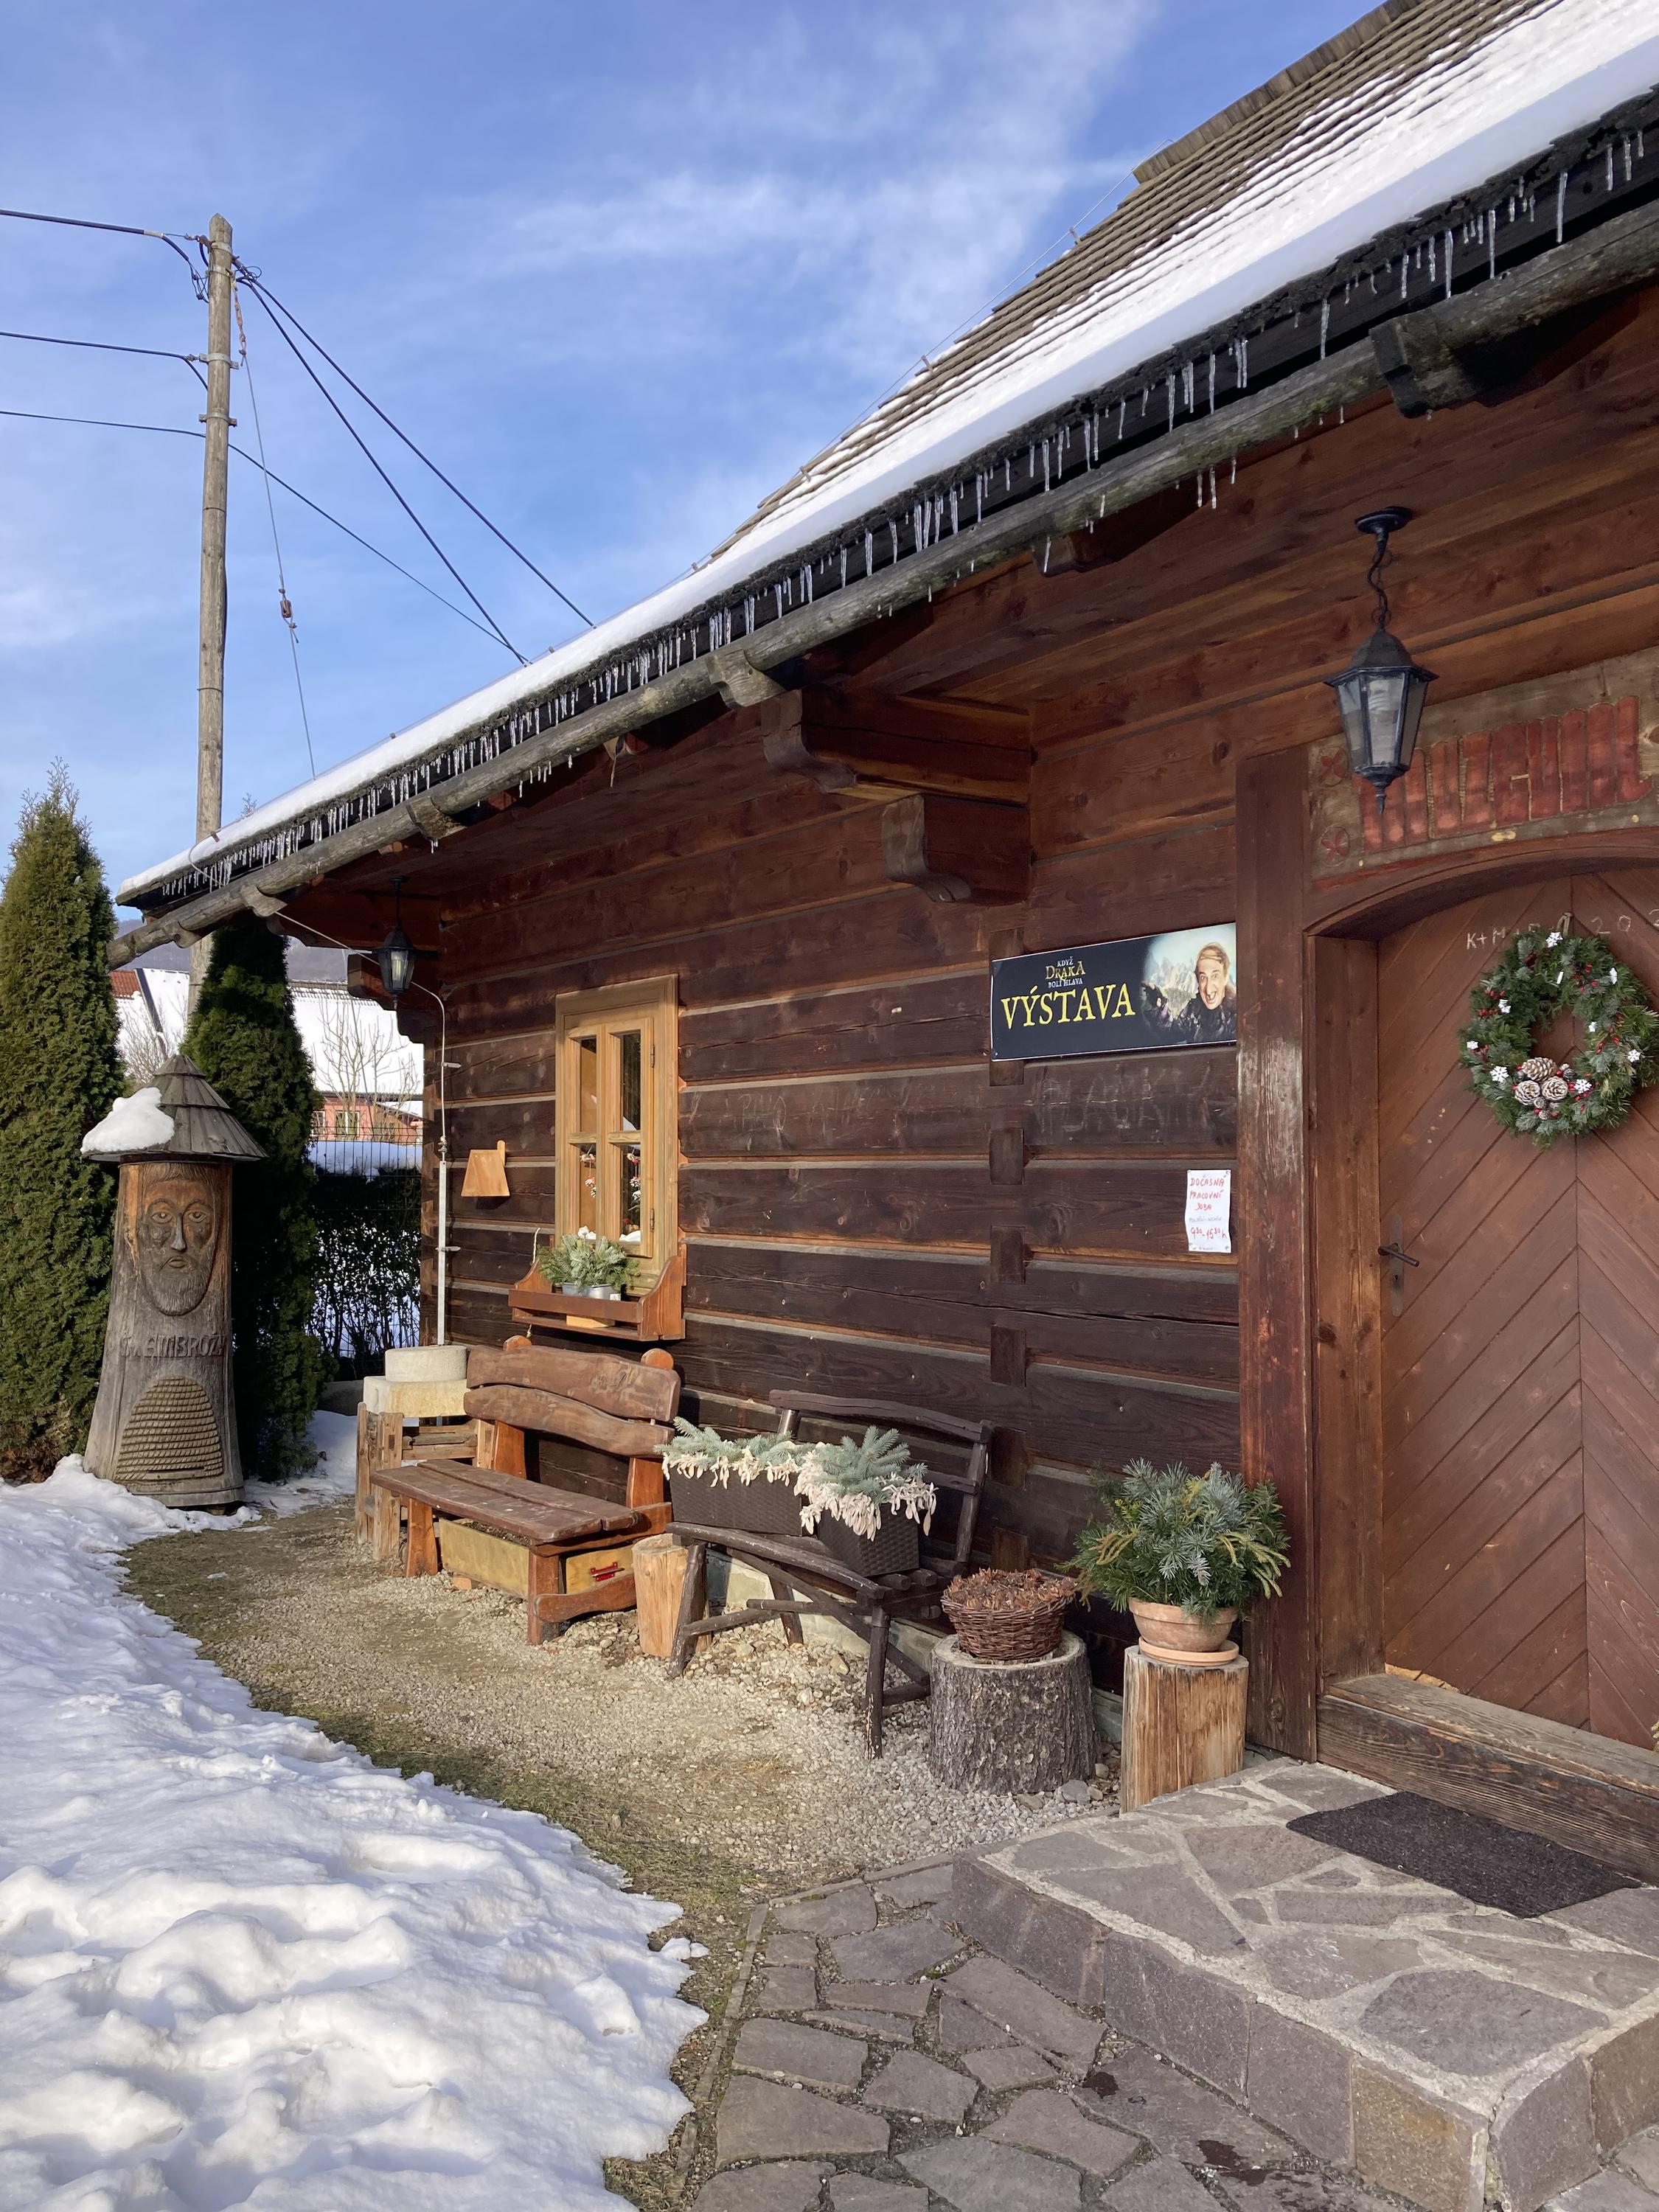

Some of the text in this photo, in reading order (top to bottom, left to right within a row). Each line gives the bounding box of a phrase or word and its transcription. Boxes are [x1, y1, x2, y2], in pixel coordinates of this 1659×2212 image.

[1057, 956, 1074, 967] KDYŽ
[1045, 960, 1086, 981] DRAKA
[1063, 978, 1083, 987] HLAVA
[1000, 983, 1136, 1030] VÝSTAVA
[1189, 1189, 1224, 1199] PRACOVNÍ
